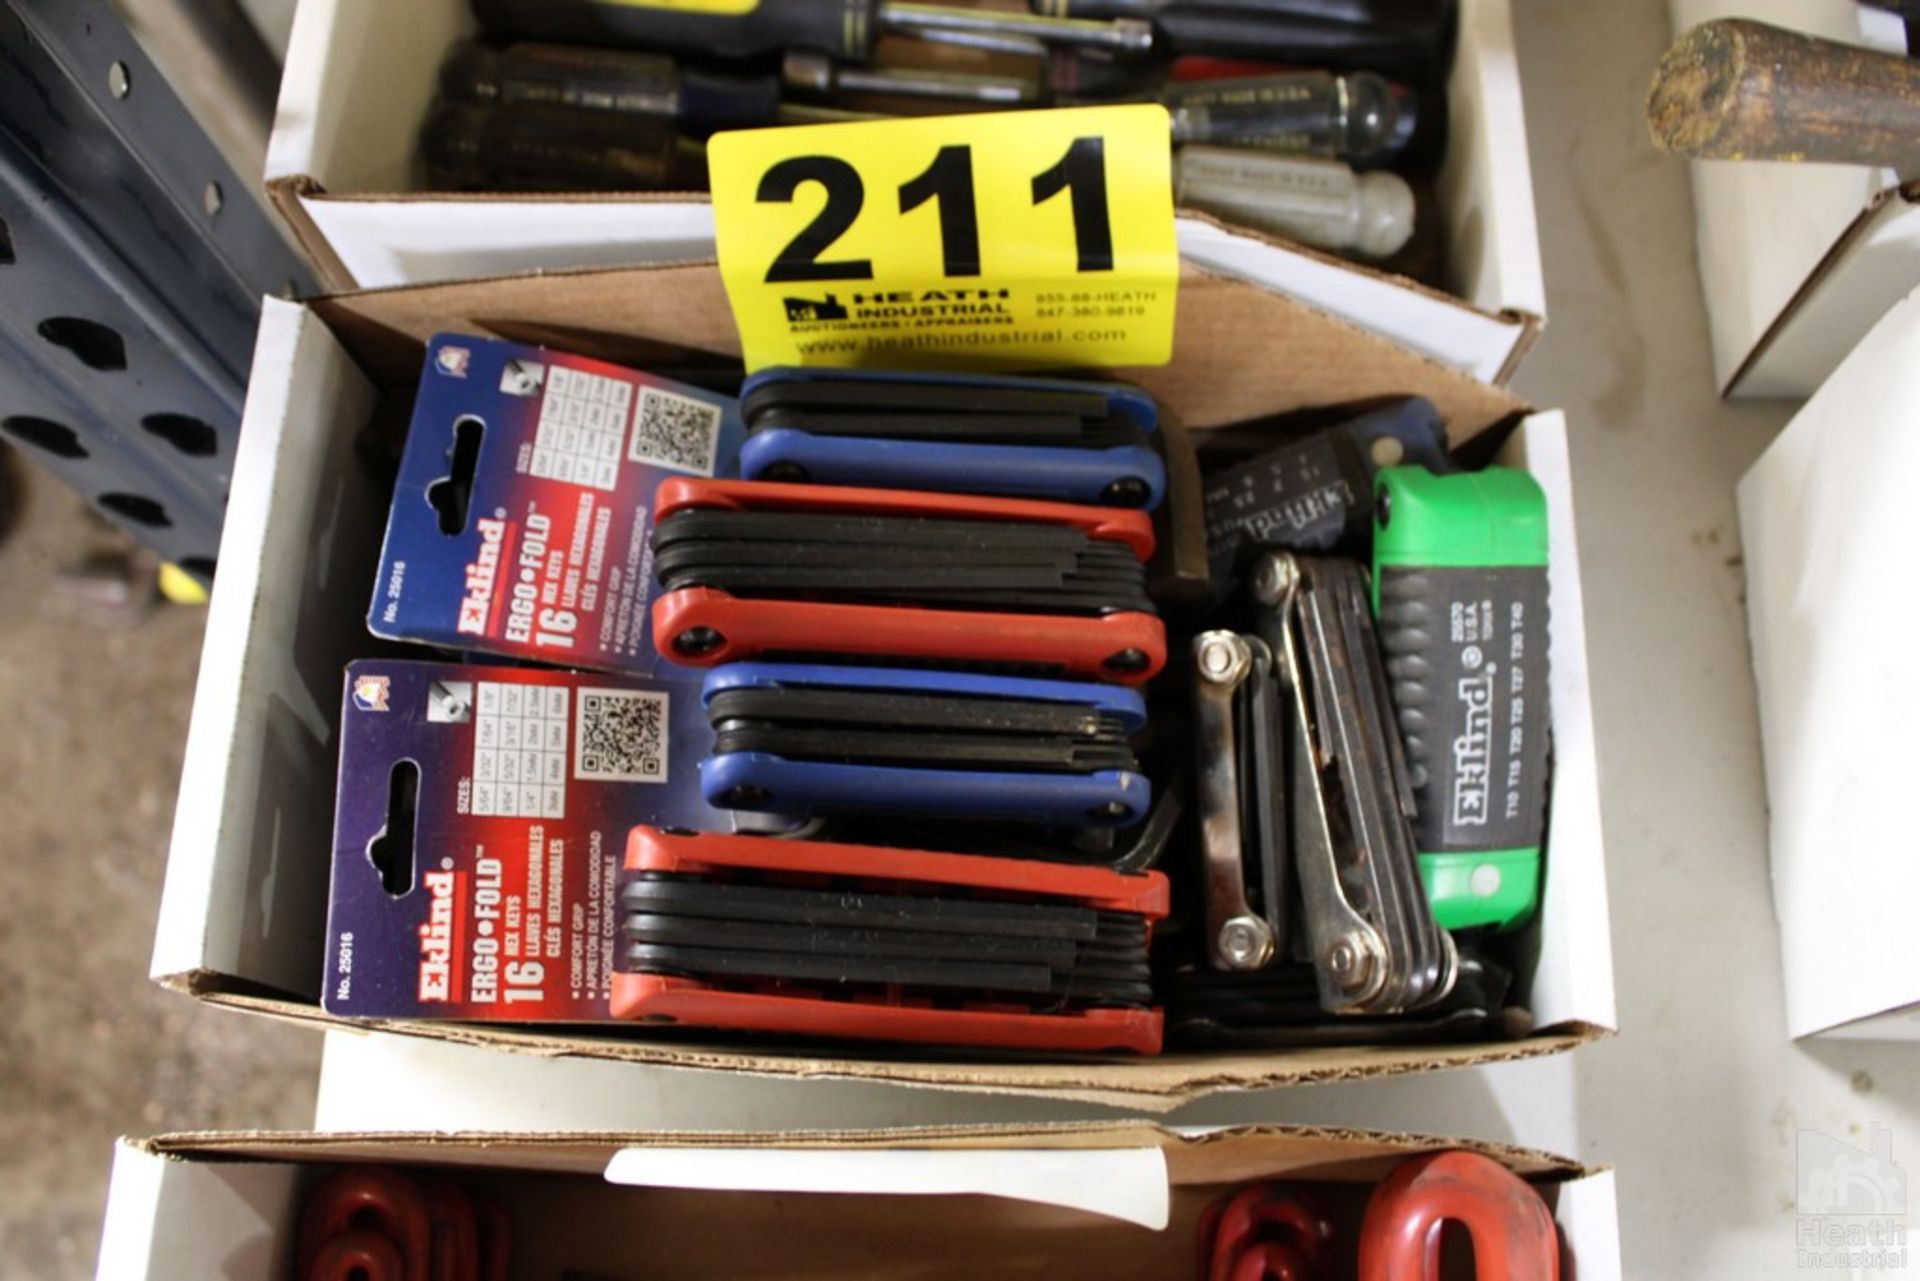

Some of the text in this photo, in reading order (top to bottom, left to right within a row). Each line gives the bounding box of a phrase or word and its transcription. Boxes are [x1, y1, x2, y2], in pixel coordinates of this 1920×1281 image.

[756, 136, 1113, 283] 211
[791, 315, 1013, 333] AUCTIONEERS APPRAISERS
[853, 288, 1009, 304] HEATH
[857, 304, 1006, 319] INDUSTRIAL
[797, 328, 1126, 354] www.heathindustrial.com
[569, 492, 594, 566] HEXAGONALES
[586, 508, 611, 581] HEXAGONALES
[384, 561, 406, 622] No. 25016
[542, 551, 563, 604] HEX KEYS
[562, 569, 579, 608] LLAVES
[601, 567, 621, 642] COMFORT GRIP
[536, 611, 577, 648] 16
[1506, 602, 1523, 819] T10 T15 T20 T25 T27 T30 T40
[458, 777, 470, 814] SIZES:
[526, 825, 544, 956] LLAVES HEXAGONALES
[589, 832, 602, 897] COMODIDAD
[505, 896, 520, 955] HEX KEYS
[544, 839, 564, 957] CLÉS HEXAGONALES
[588, 918, 599, 932] DE
[589, 901, 599, 915] LA
[603, 855, 616, 936] CONFORTABLE
[338, 932, 353, 1000] No. 25016
[572, 903, 584, 988] COMFORT GRIP
[505, 961, 544, 1003] 16
